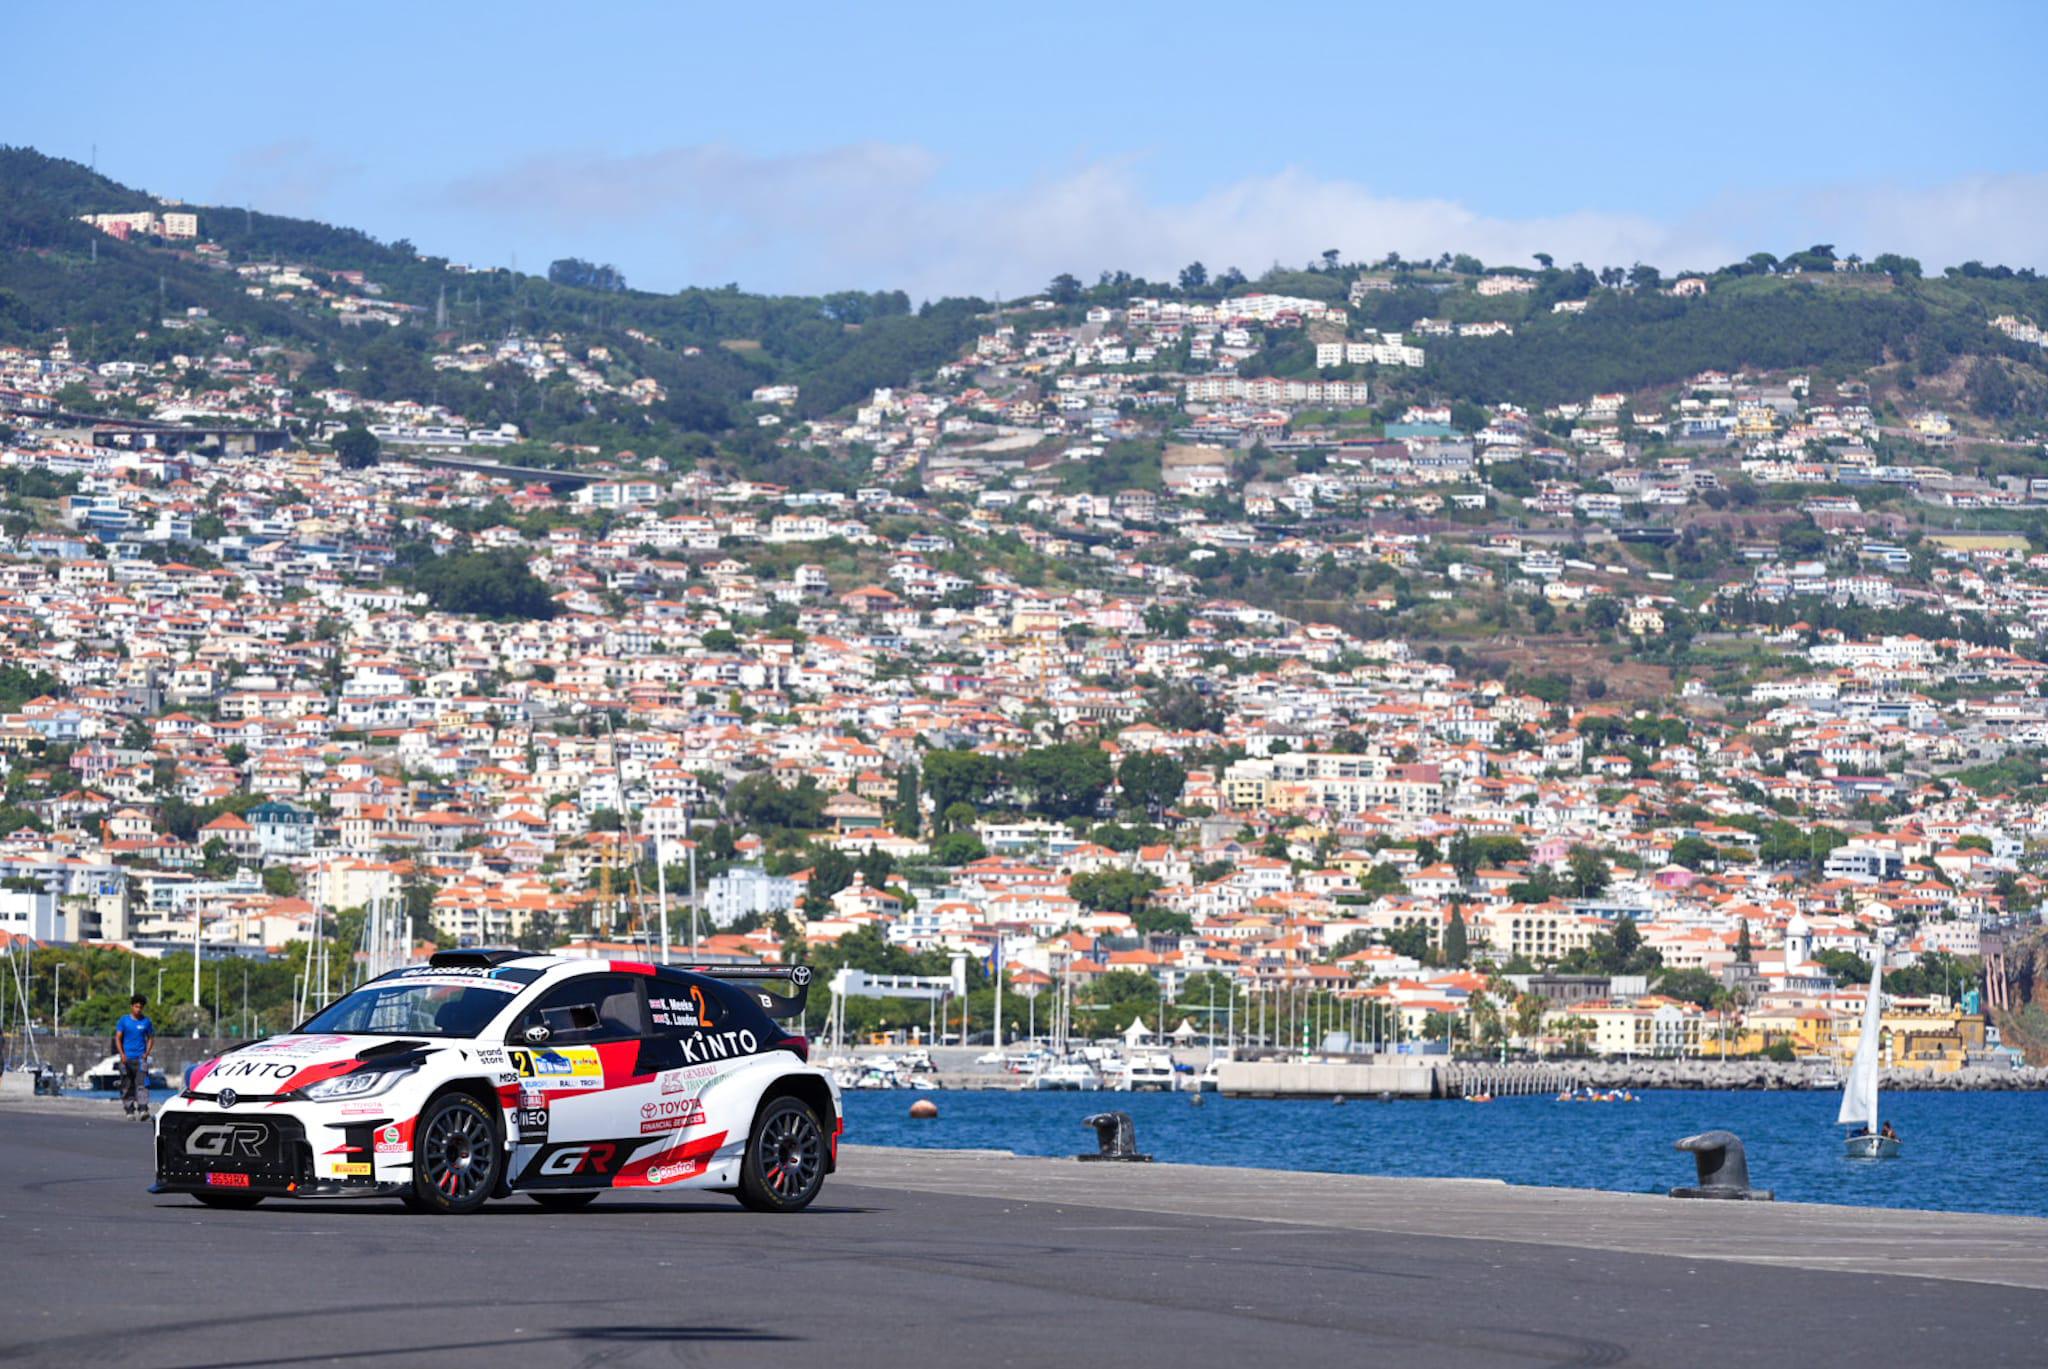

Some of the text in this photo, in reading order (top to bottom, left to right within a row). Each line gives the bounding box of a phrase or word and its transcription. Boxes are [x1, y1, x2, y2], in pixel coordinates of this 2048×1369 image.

[661, 999, 694, 1011] K. Meeke
[690, 985, 714, 1027] 2
[664, 1013, 673, 1025] S.
[477, 1049, 503, 1057] brand
[480, 1056, 504, 1065] store
[514, 1052, 530, 1077] 2
[500, 1073, 518, 1082] MDS
[659, 1098, 703, 1114] TOYOTA
[642, 1120, 672, 1132] FINANCIAL
[185, 1123, 269, 1157] GR
[540, 1143, 616, 1175] GR
[659, 1159, 696, 1179] Castrol
